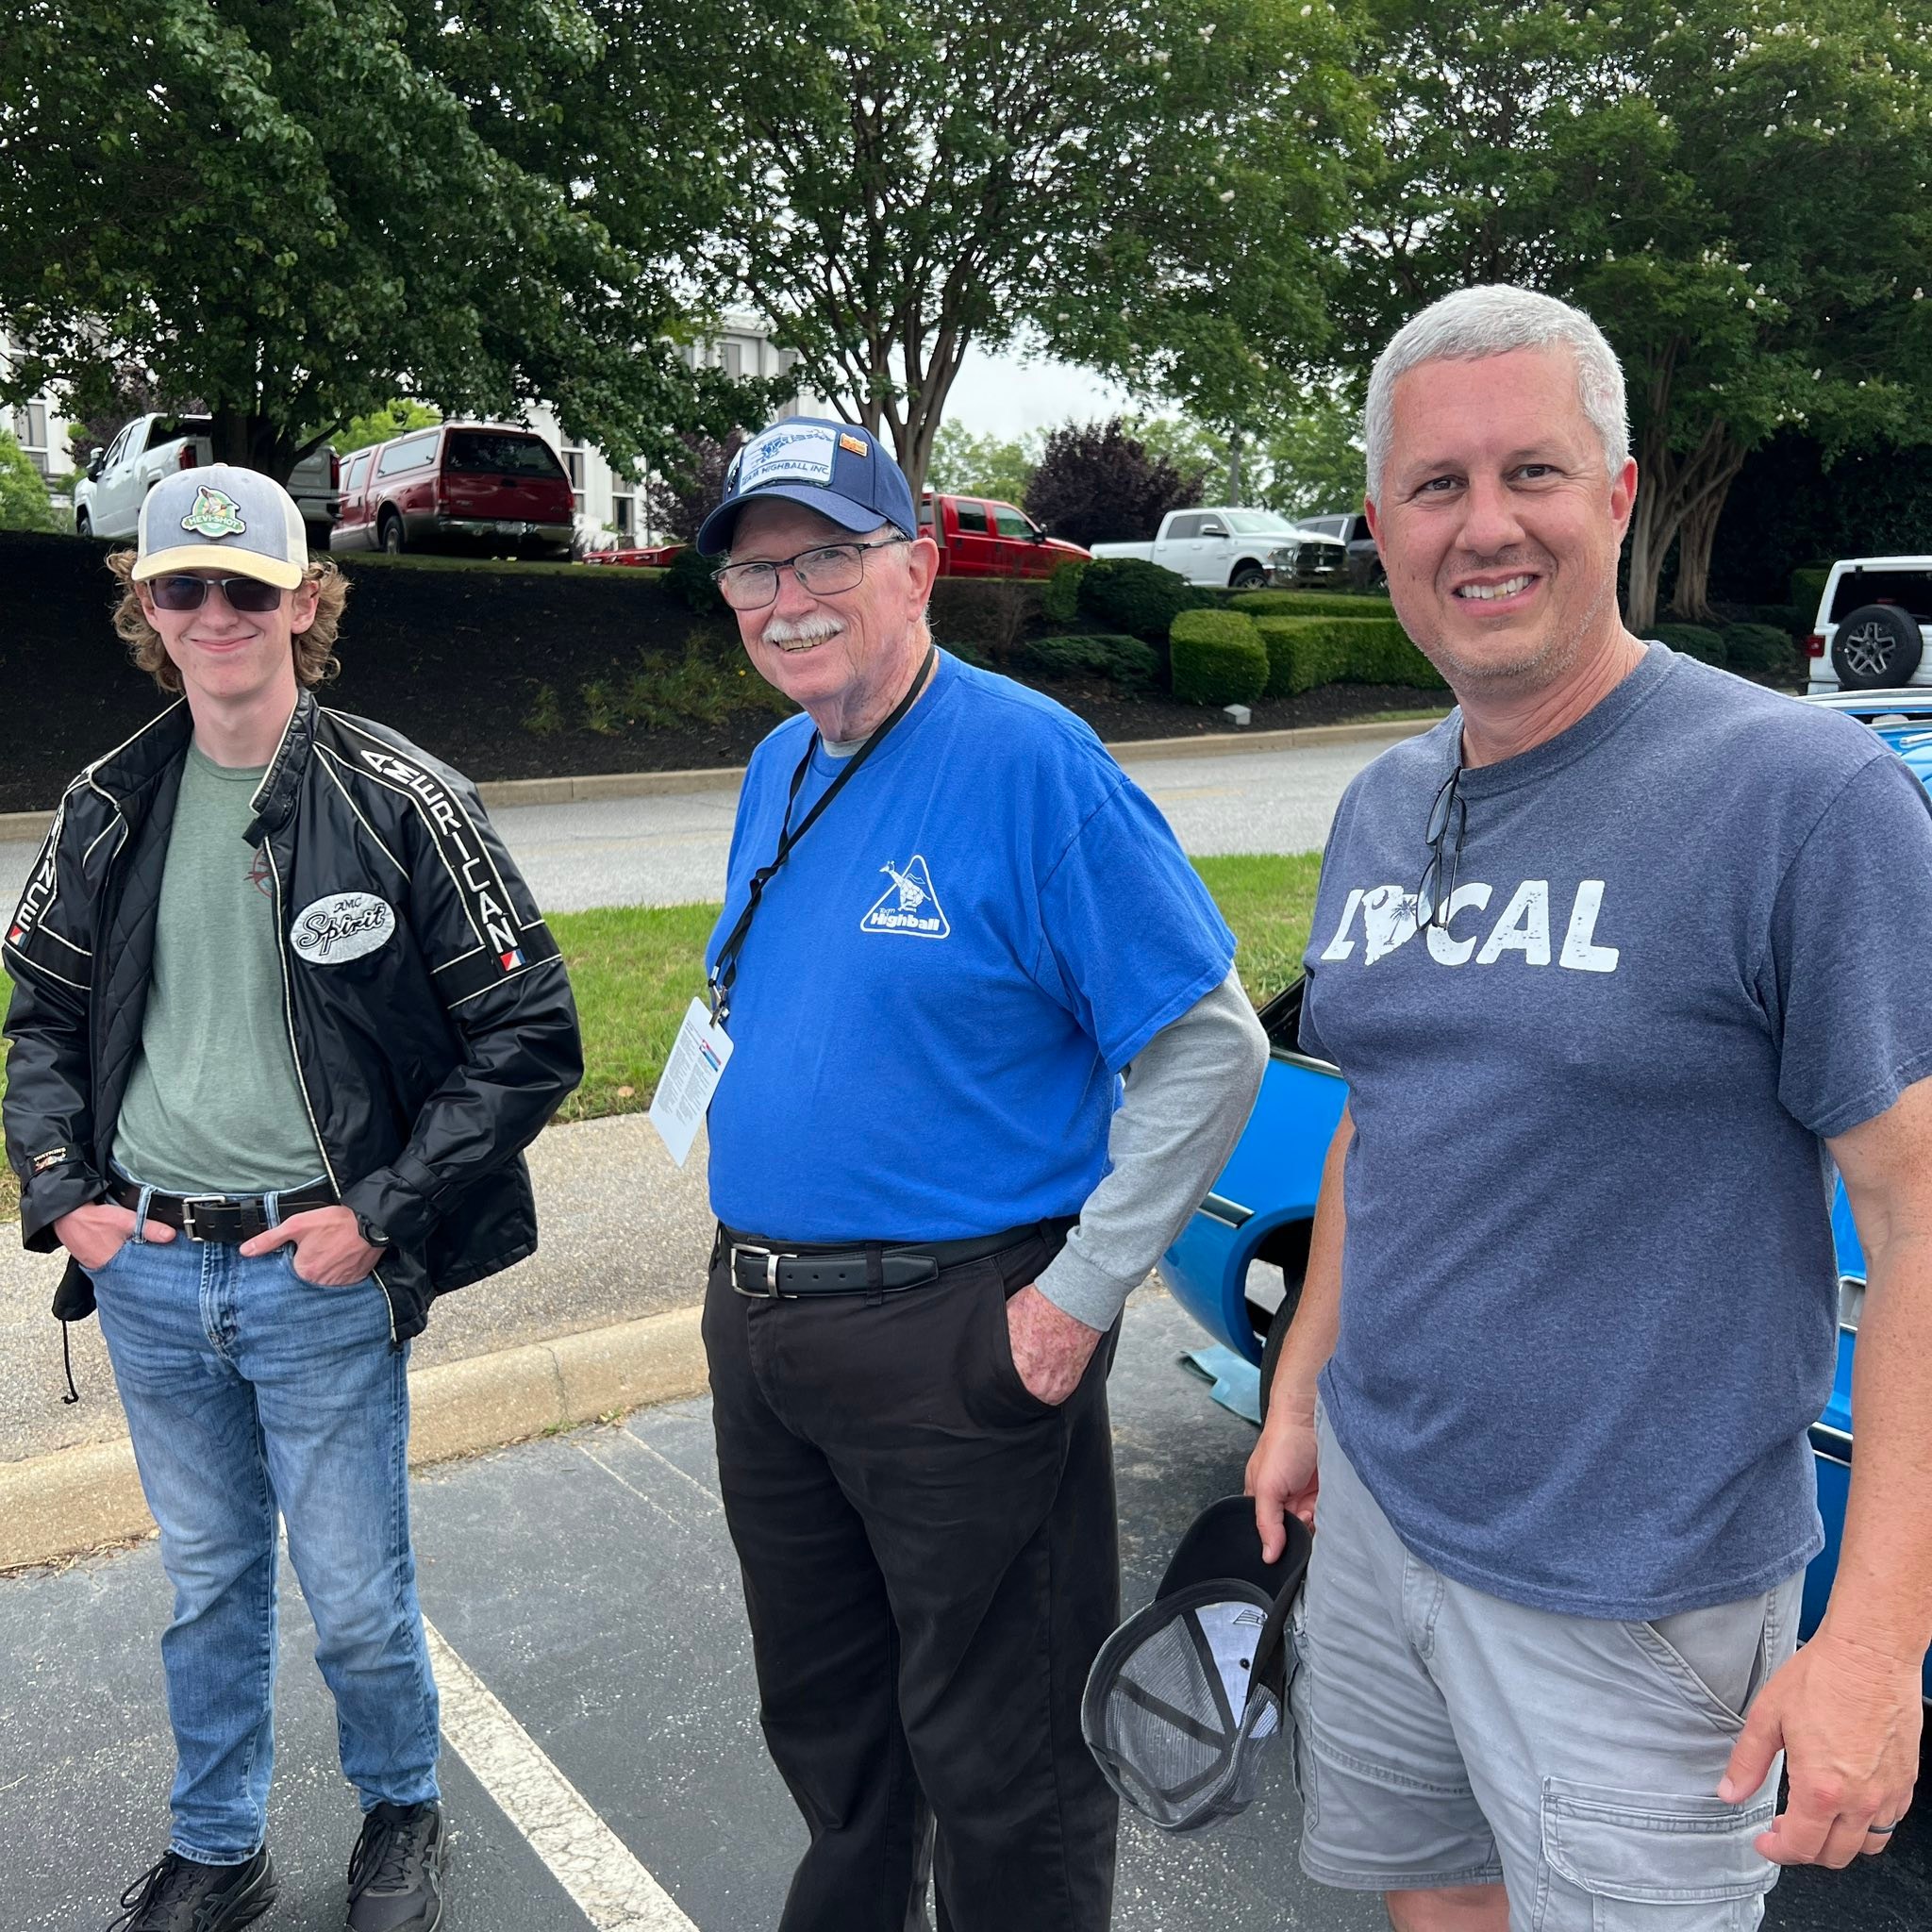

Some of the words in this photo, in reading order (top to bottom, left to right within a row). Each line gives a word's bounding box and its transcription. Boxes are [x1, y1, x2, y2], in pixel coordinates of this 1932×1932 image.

[761, 462, 808, 475] HIGHBALL
[810, 464, 829, 475] INC
[189, 514, 240, 530] HEVI-SHOT
[359, 749, 518, 954] AMERICAN
[333, 896, 362, 913] AMC
[296, 902, 387, 957] Spirit
[870, 911, 941, 932] Highball
